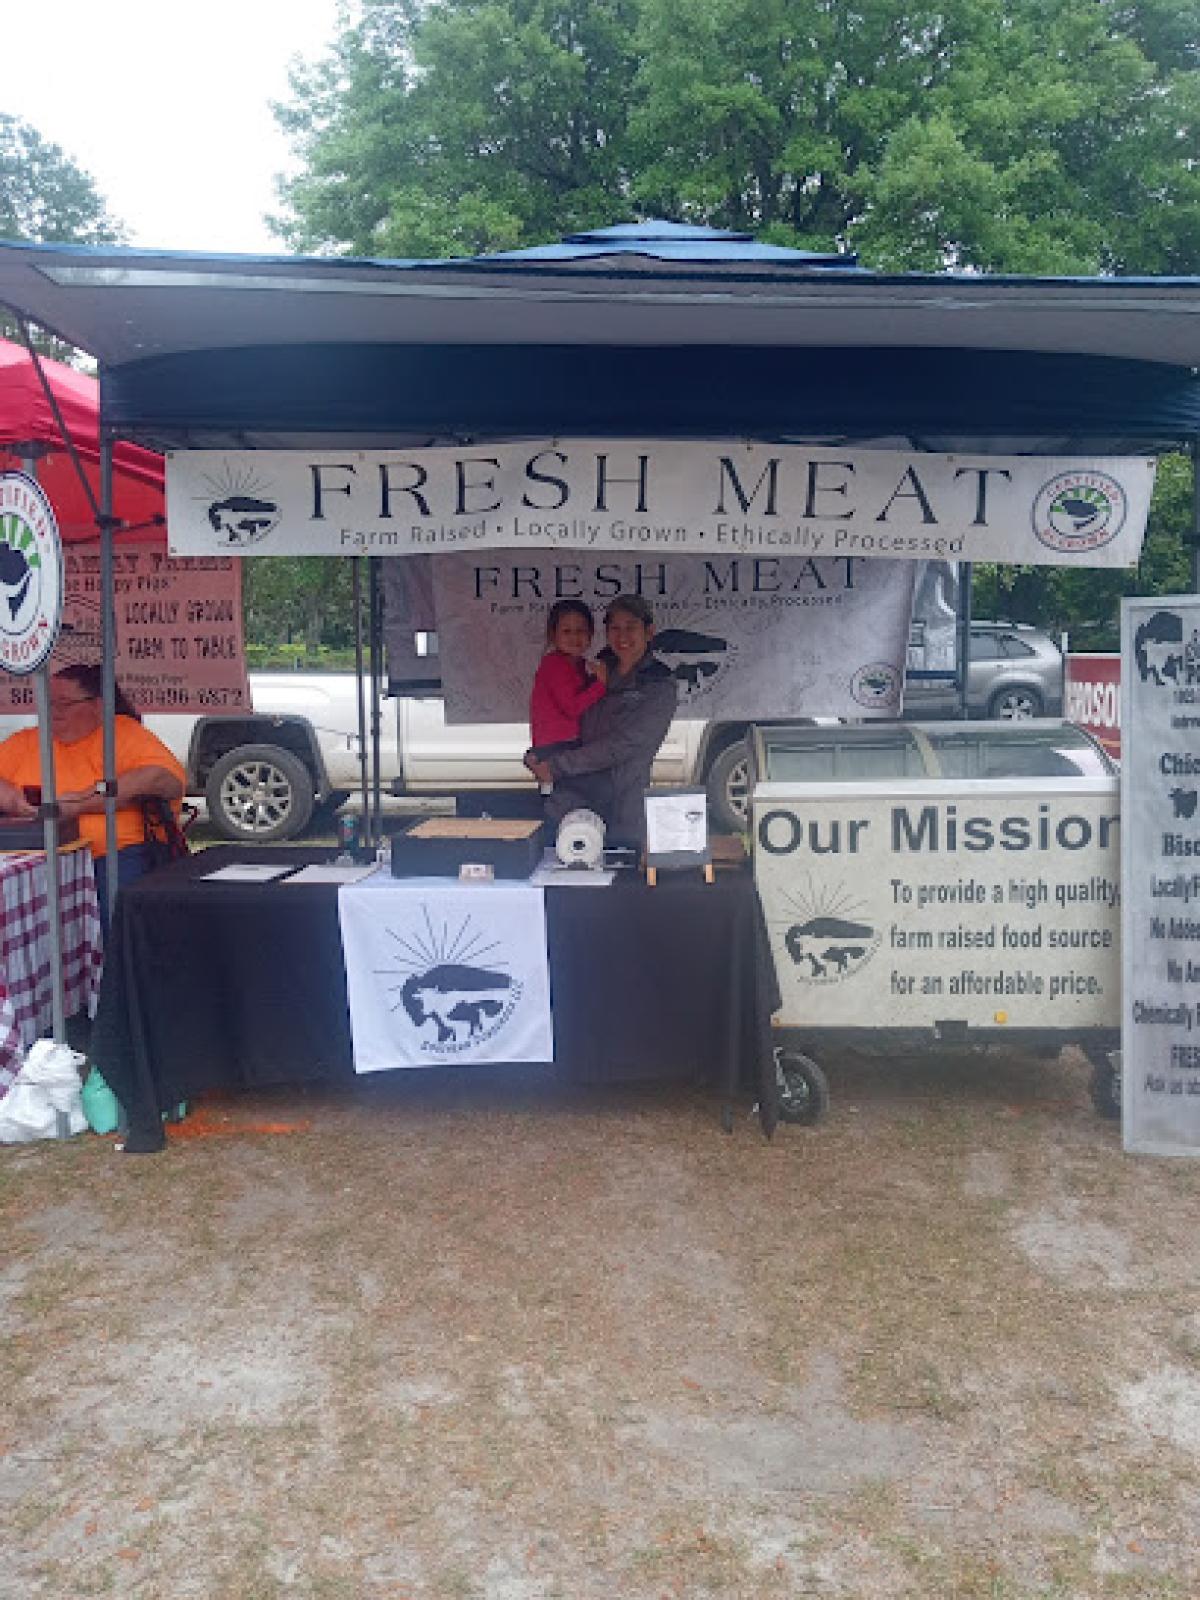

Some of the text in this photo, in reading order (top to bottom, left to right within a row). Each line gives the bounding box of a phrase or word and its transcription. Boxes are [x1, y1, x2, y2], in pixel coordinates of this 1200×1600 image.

[308, 449, 1012, 527] FRESH MEAT
[340, 517, 966, 556] Farm Raised Locally Grown Ethically Processed
[473, 557, 866, 599] FRESH MEAT
[126, 599, 234, 625] LOCALLY GROWN
[128, 636, 166, 660] FARM
[170, 636, 187, 660] TO
[194, 634, 236, 660] TABLE
[758, 808, 871, 855] Our
[890, 879, 914, 904] To
[917, 879, 986, 909] provide
[991, 884, 1004, 904] a
[1008, 879, 1048, 909] high
[890, 923, 1113, 948] farm raised food source
[890, 970, 1104, 1000] for an affordable price.
